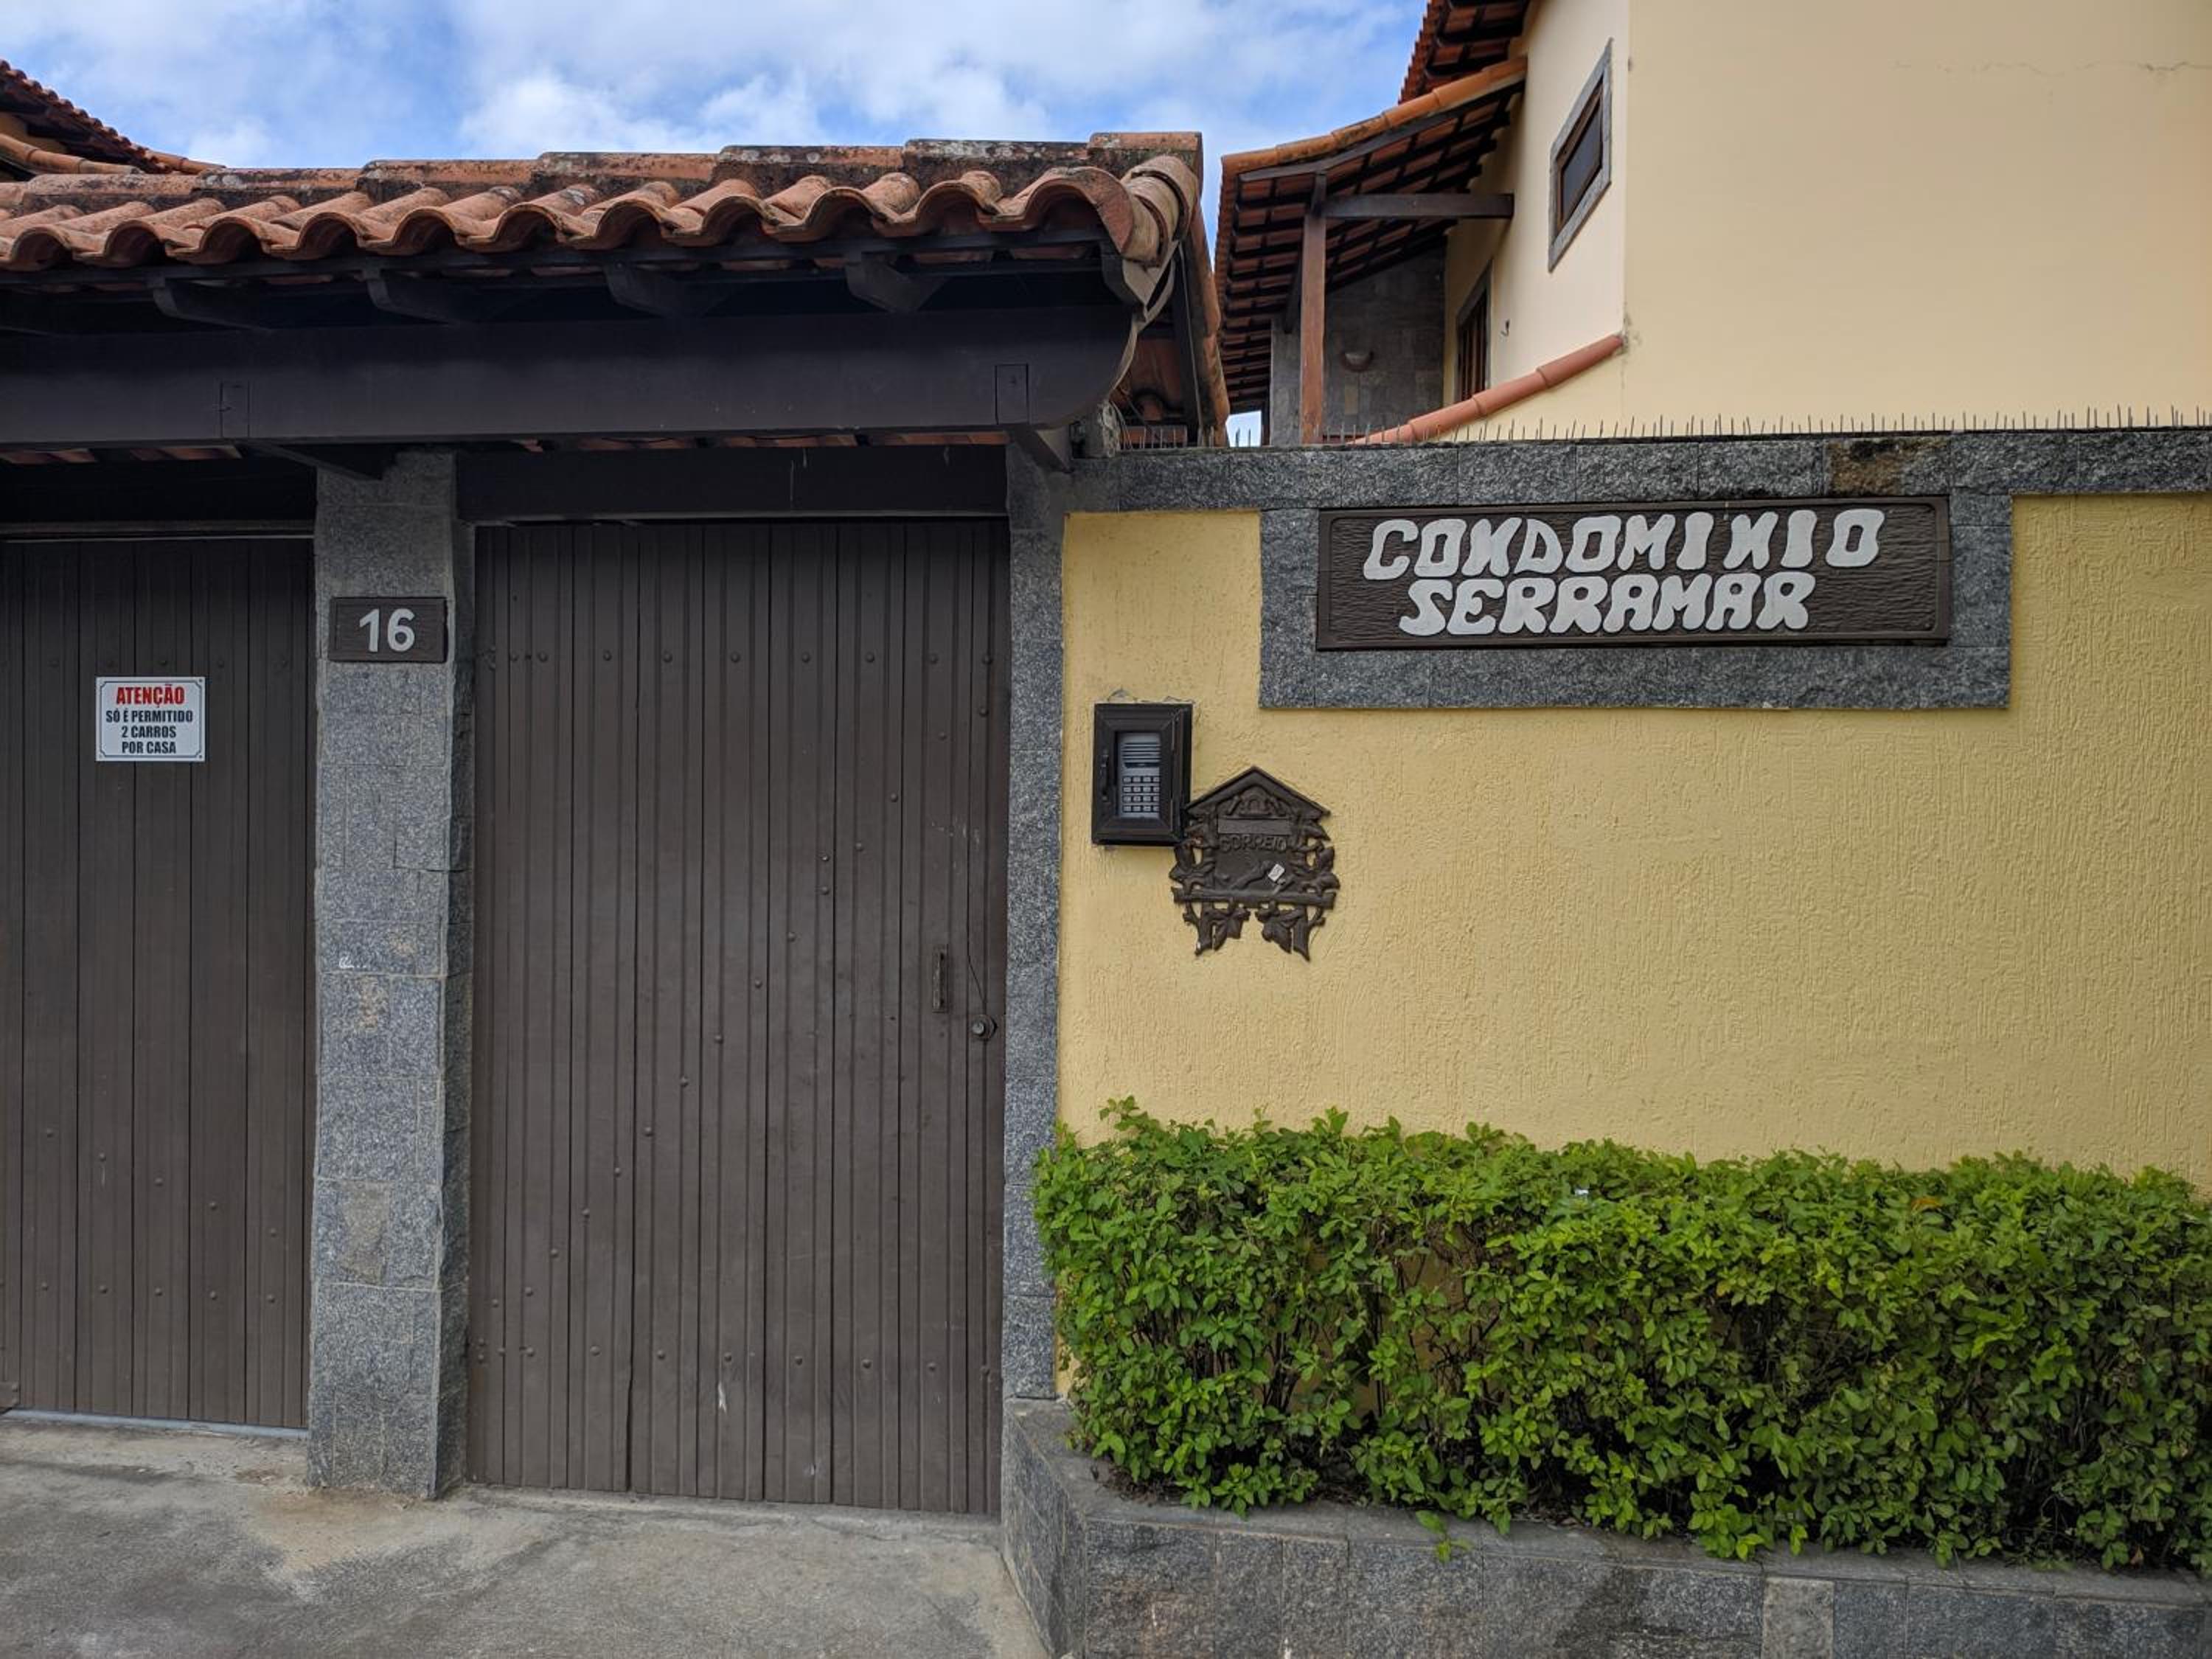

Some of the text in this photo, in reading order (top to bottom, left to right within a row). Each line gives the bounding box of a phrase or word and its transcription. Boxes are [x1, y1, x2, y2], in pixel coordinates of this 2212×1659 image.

[1363, 509, 1885, 581] CONDOMINIO
[1398, 571, 1816, 636] SERRAMAR
[359, 608, 415, 652] 16
[116, 684, 185, 708] ATENÇÃO
[105, 709, 193, 723] SÓ É PERMITIDO
[121, 726, 176, 738] 2 CARROS
[122, 742, 176, 754] POR CASA
[1220, 834, 1287, 851] CORREIO
